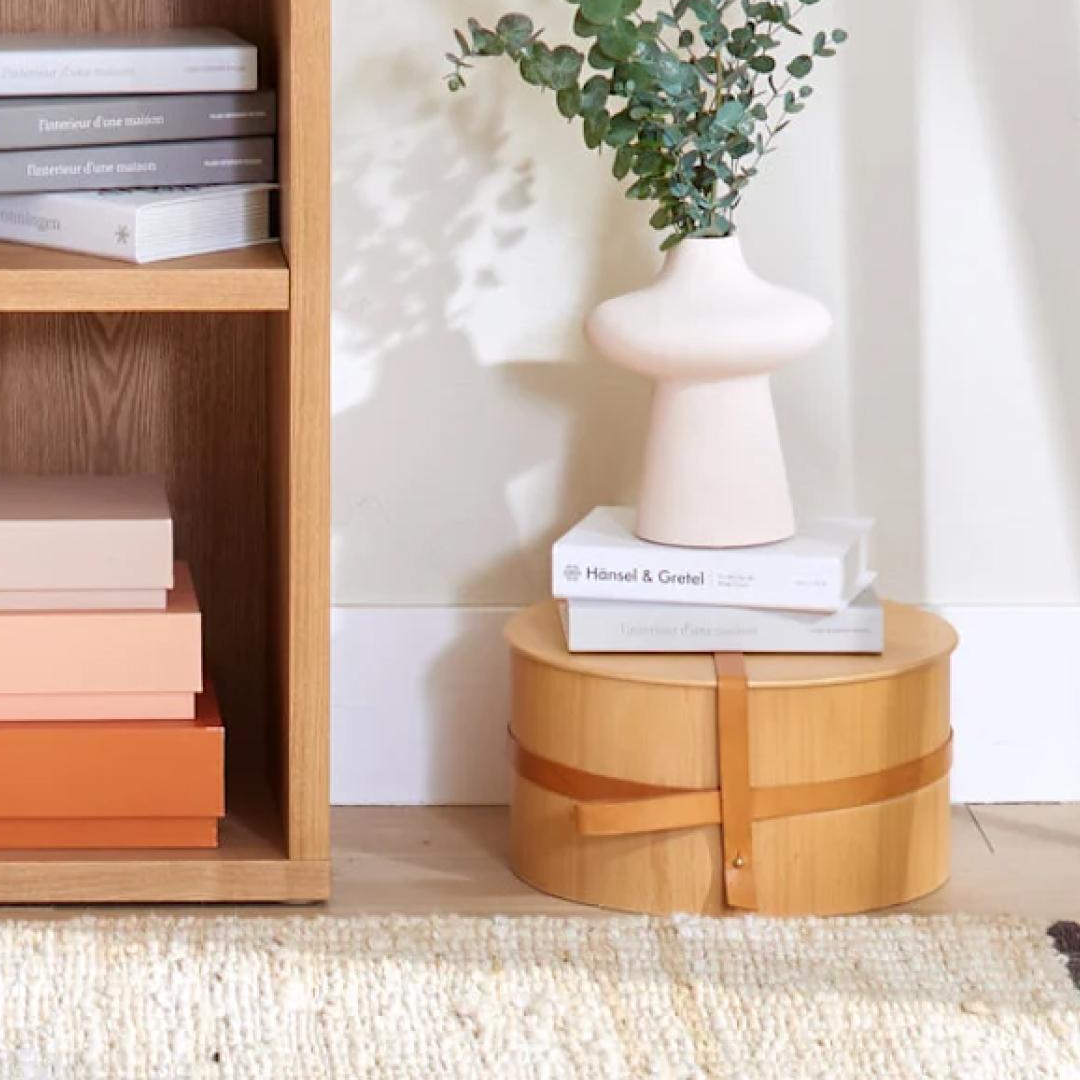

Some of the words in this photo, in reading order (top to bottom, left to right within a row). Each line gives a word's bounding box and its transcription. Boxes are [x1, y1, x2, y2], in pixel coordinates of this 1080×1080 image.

[586, 565, 637, 583] Hänsel
[642, 569, 654, 584] &
[658, 570, 704, 586] Gretel
